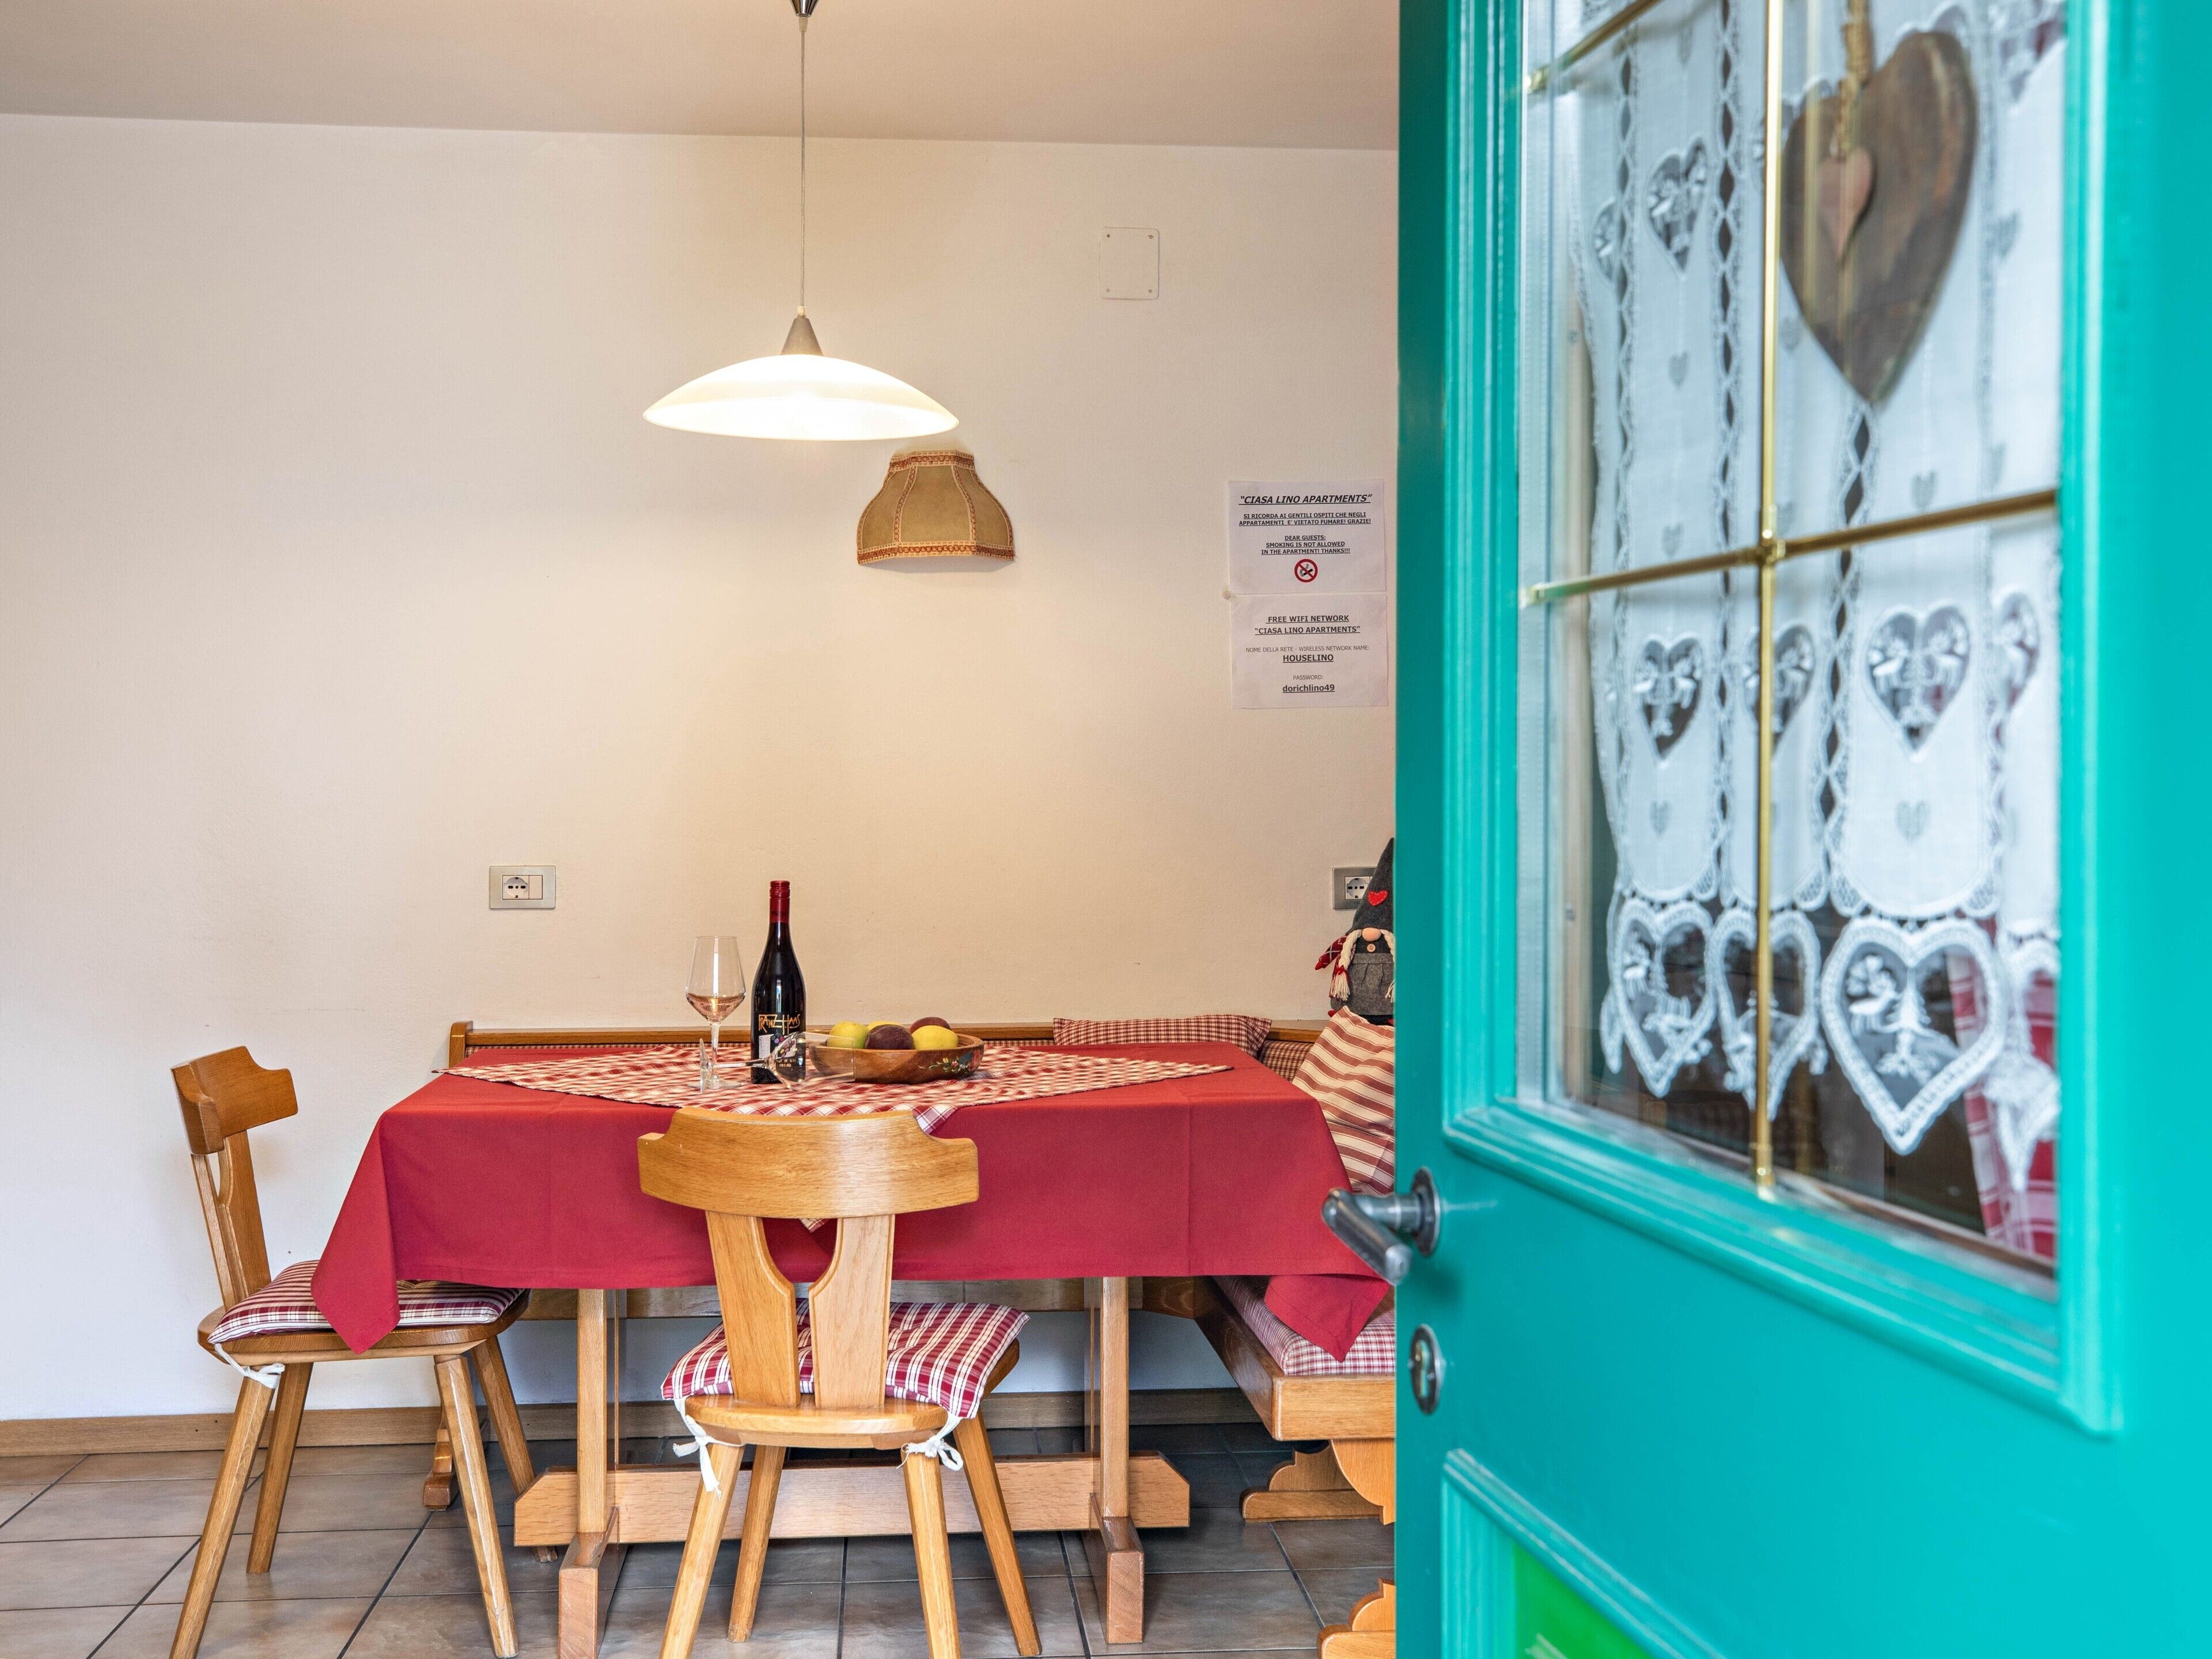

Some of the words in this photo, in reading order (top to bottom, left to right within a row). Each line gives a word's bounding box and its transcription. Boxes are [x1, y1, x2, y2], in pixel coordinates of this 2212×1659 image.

[1240, 495, 1273, 504] "CIASA
[1276, 495, 1301, 503] LINO
[1302, 494, 1372, 503] APARTMENTS"
[1283, 654, 1334, 662] HOUSELINO
[1282, 684, 1335, 692] dorichlino49
[758, 1014, 782, 1033] FRANZ
[782, 1014, 800, 1035] HAAS
